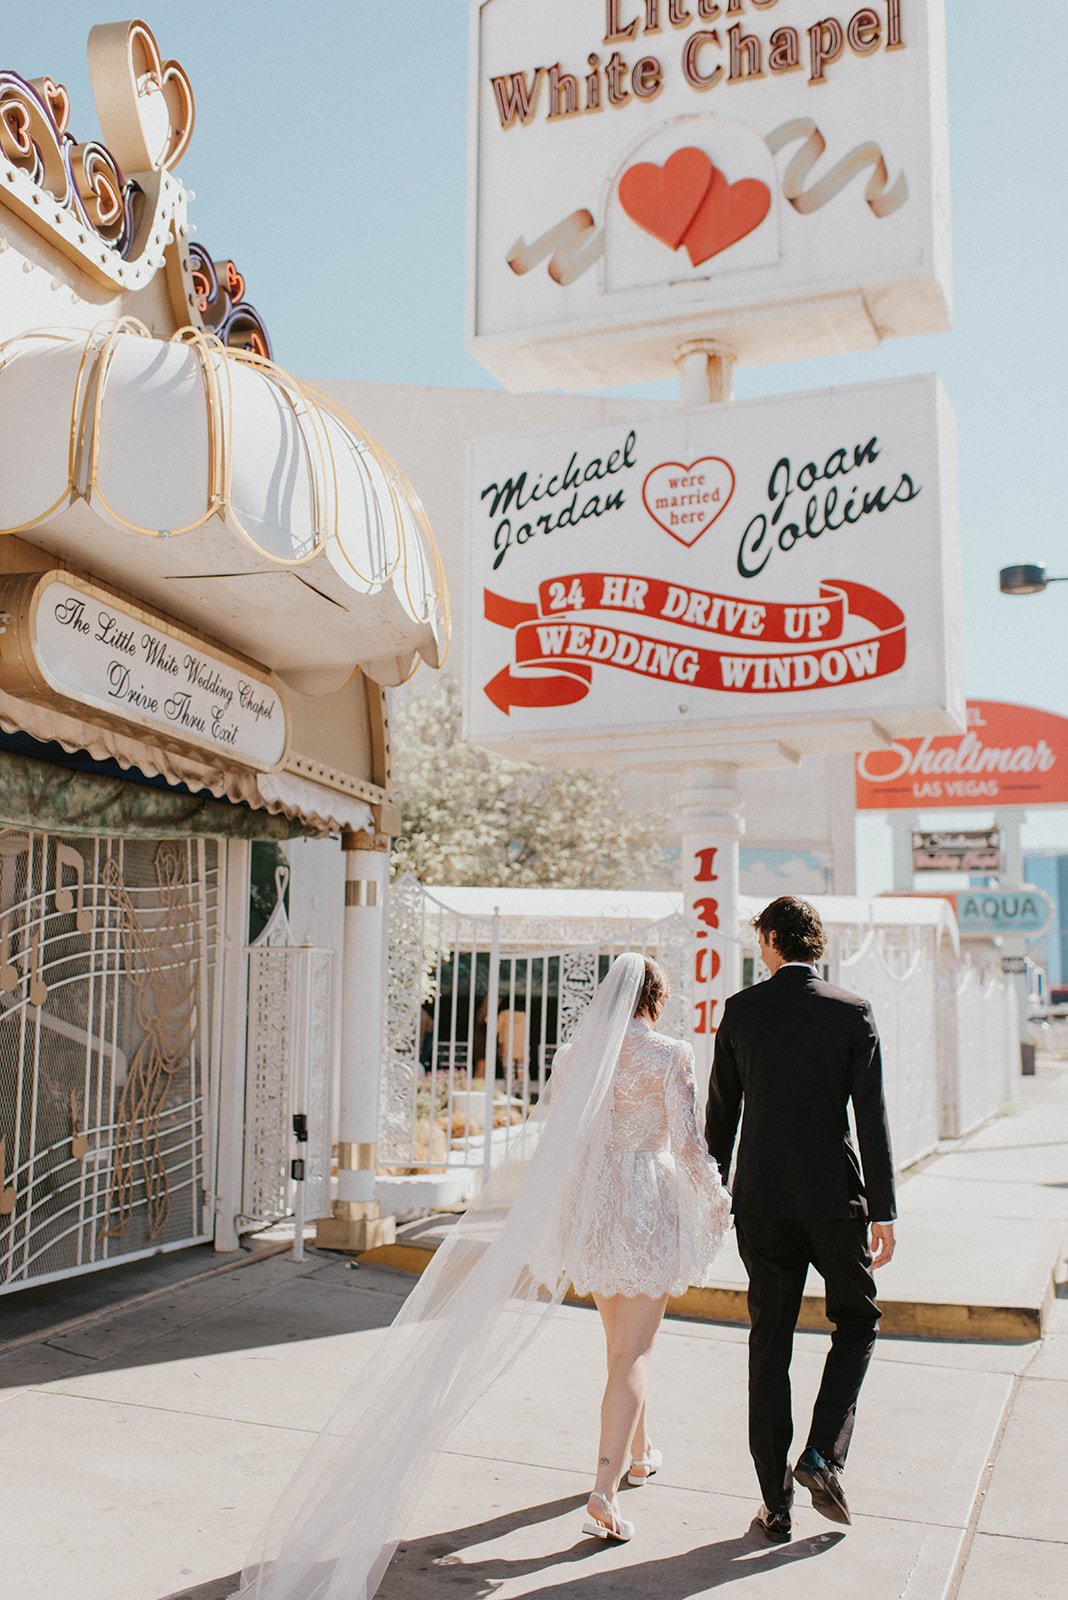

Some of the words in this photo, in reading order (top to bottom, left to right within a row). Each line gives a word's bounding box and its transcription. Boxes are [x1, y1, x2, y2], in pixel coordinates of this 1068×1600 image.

[490, 53, 663, 130] White
[682, 0, 905, 93] Chapel
[481, 430, 637, 518] Michael
[655, 487, 720, 509] married
[668, 474, 705, 489] were
[768, 435, 881, 524] Joan
[492, 486, 625, 571] Jordan
[670, 511, 705, 526] here
[737, 473, 922, 578] Collins
[548, 581, 585, 609] 24
[601, 576, 649, 611] HR
[661, 586, 766, 637] DRIVE
[783, 605, 831, 639] UP
[54, 597, 91, 635] The
[95, 611, 136, 656] Little
[141, 634, 180, 676] White
[183, 654, 234, 705] Wedding
[237, 680, 275, 722] Chapel
[536, 626, 699, 685] WEDDING
[719, 641, 881, 689] WINDOW
[107, 661, 159, 713] Drive
[164, 691, 206, 734] Thru
[211, 705, 240, 745] Exit
[858, 731, 1056, 782] Shalimar
[912, 781, 942, 798] LAS
[944, 779, 999, 797] VEGAS
[964, 898, 1038, 919] AQUA
